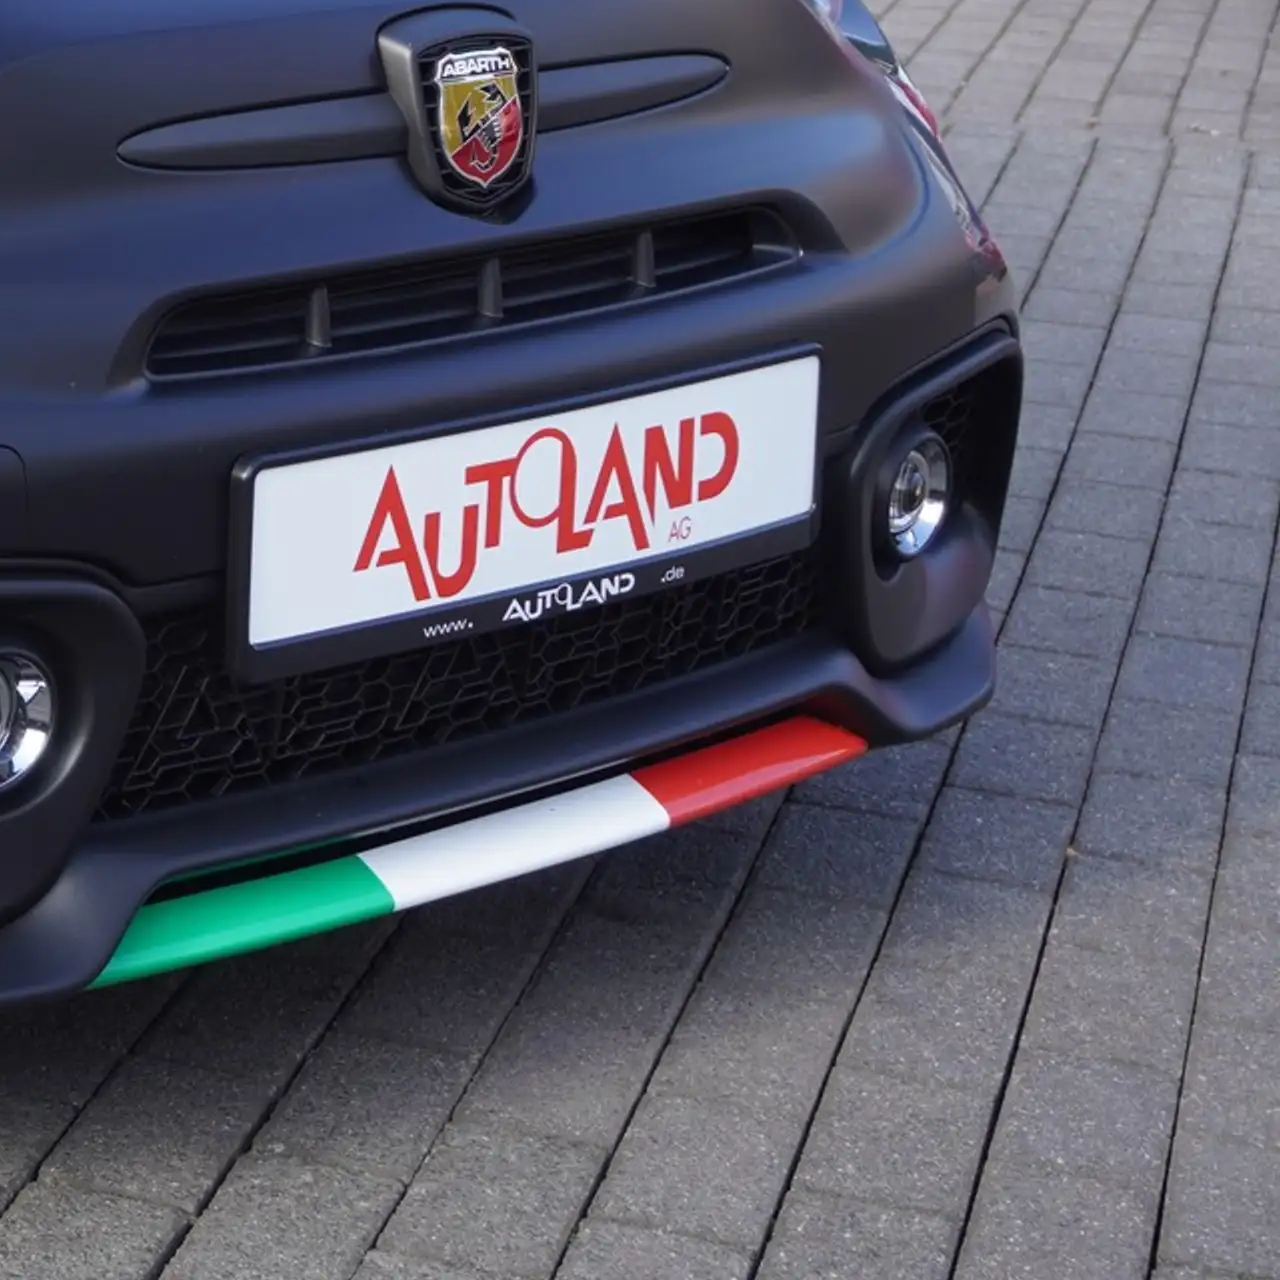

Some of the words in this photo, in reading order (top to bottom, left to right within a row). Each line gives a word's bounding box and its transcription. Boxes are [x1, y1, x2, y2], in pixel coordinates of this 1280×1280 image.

[443, 56, 510, 77] ABARTH
[353, 411, 740, 602] AUTOLAND
[668, 516, 692, 543] AG
[423, 618, 474, 638] www.
[502, 572, 636, 621] AUTOLAND
[660, 565, 685, 584] .de
